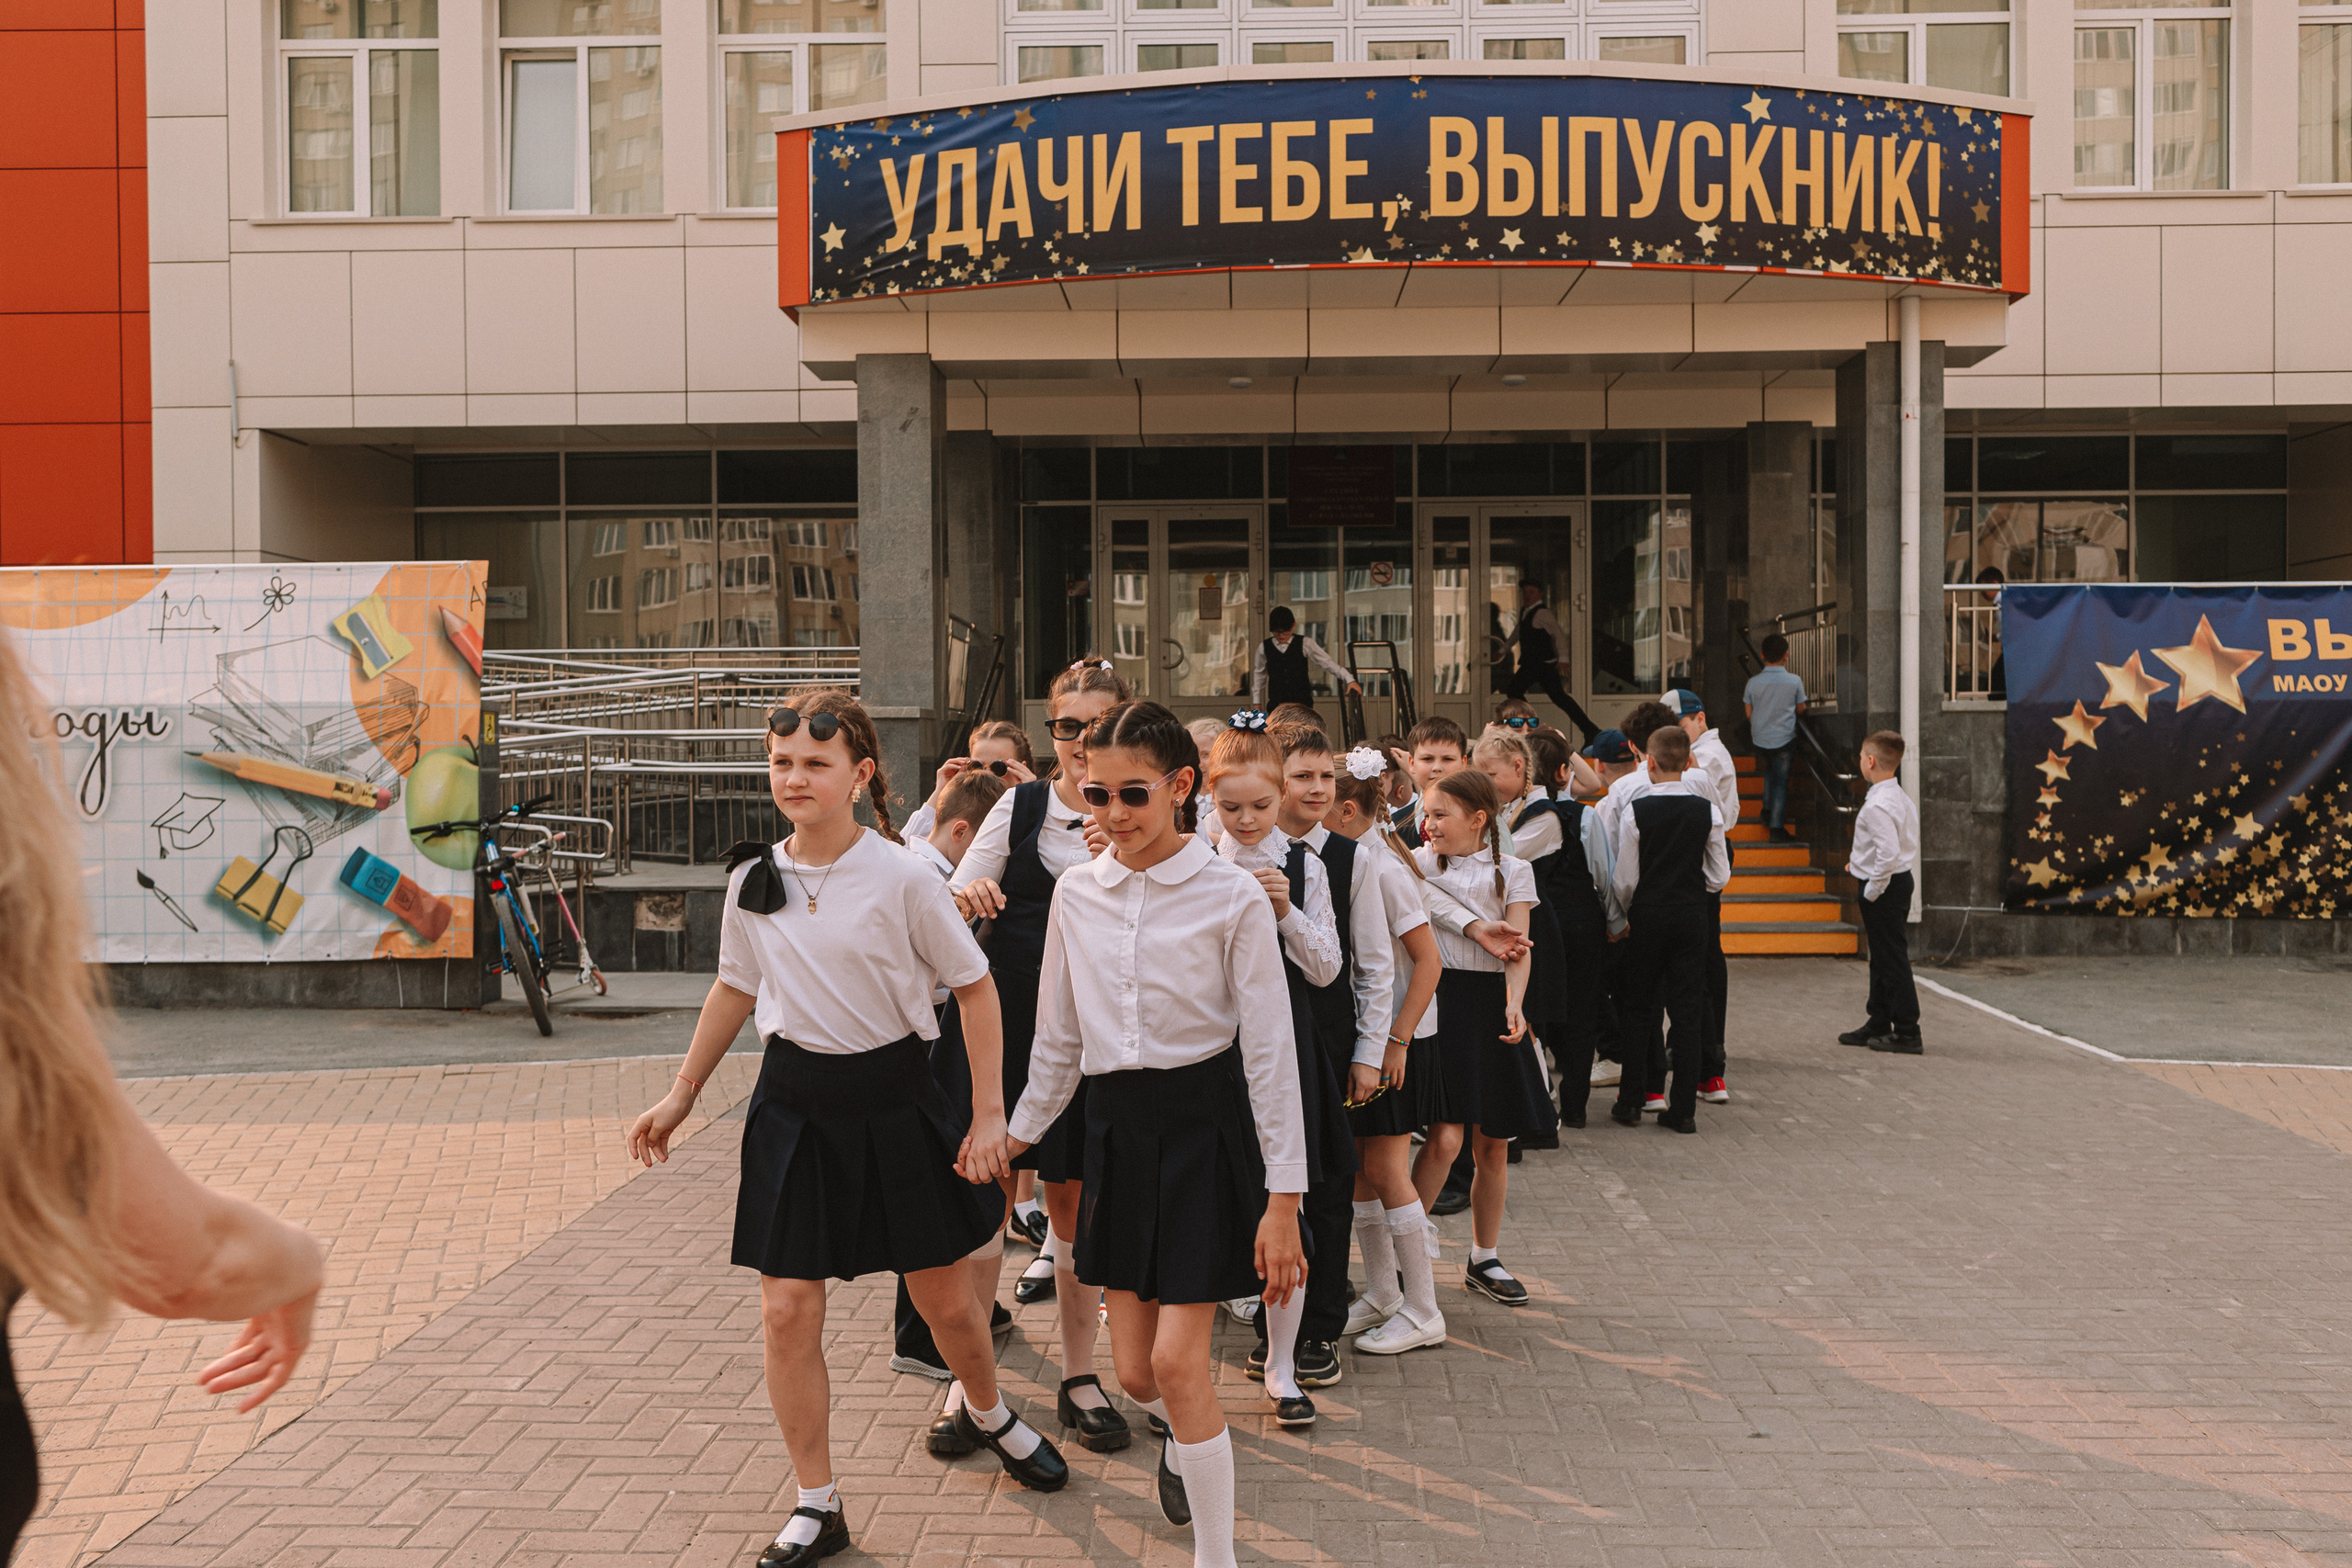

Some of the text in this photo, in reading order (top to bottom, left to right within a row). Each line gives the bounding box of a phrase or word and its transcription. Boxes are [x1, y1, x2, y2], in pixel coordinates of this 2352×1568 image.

[879, 116, 1941, 261] УДАЧИ ТЕБЕ, ВЫПУСКНИК!
[2272, 673, 2348, 693] МАОУ
